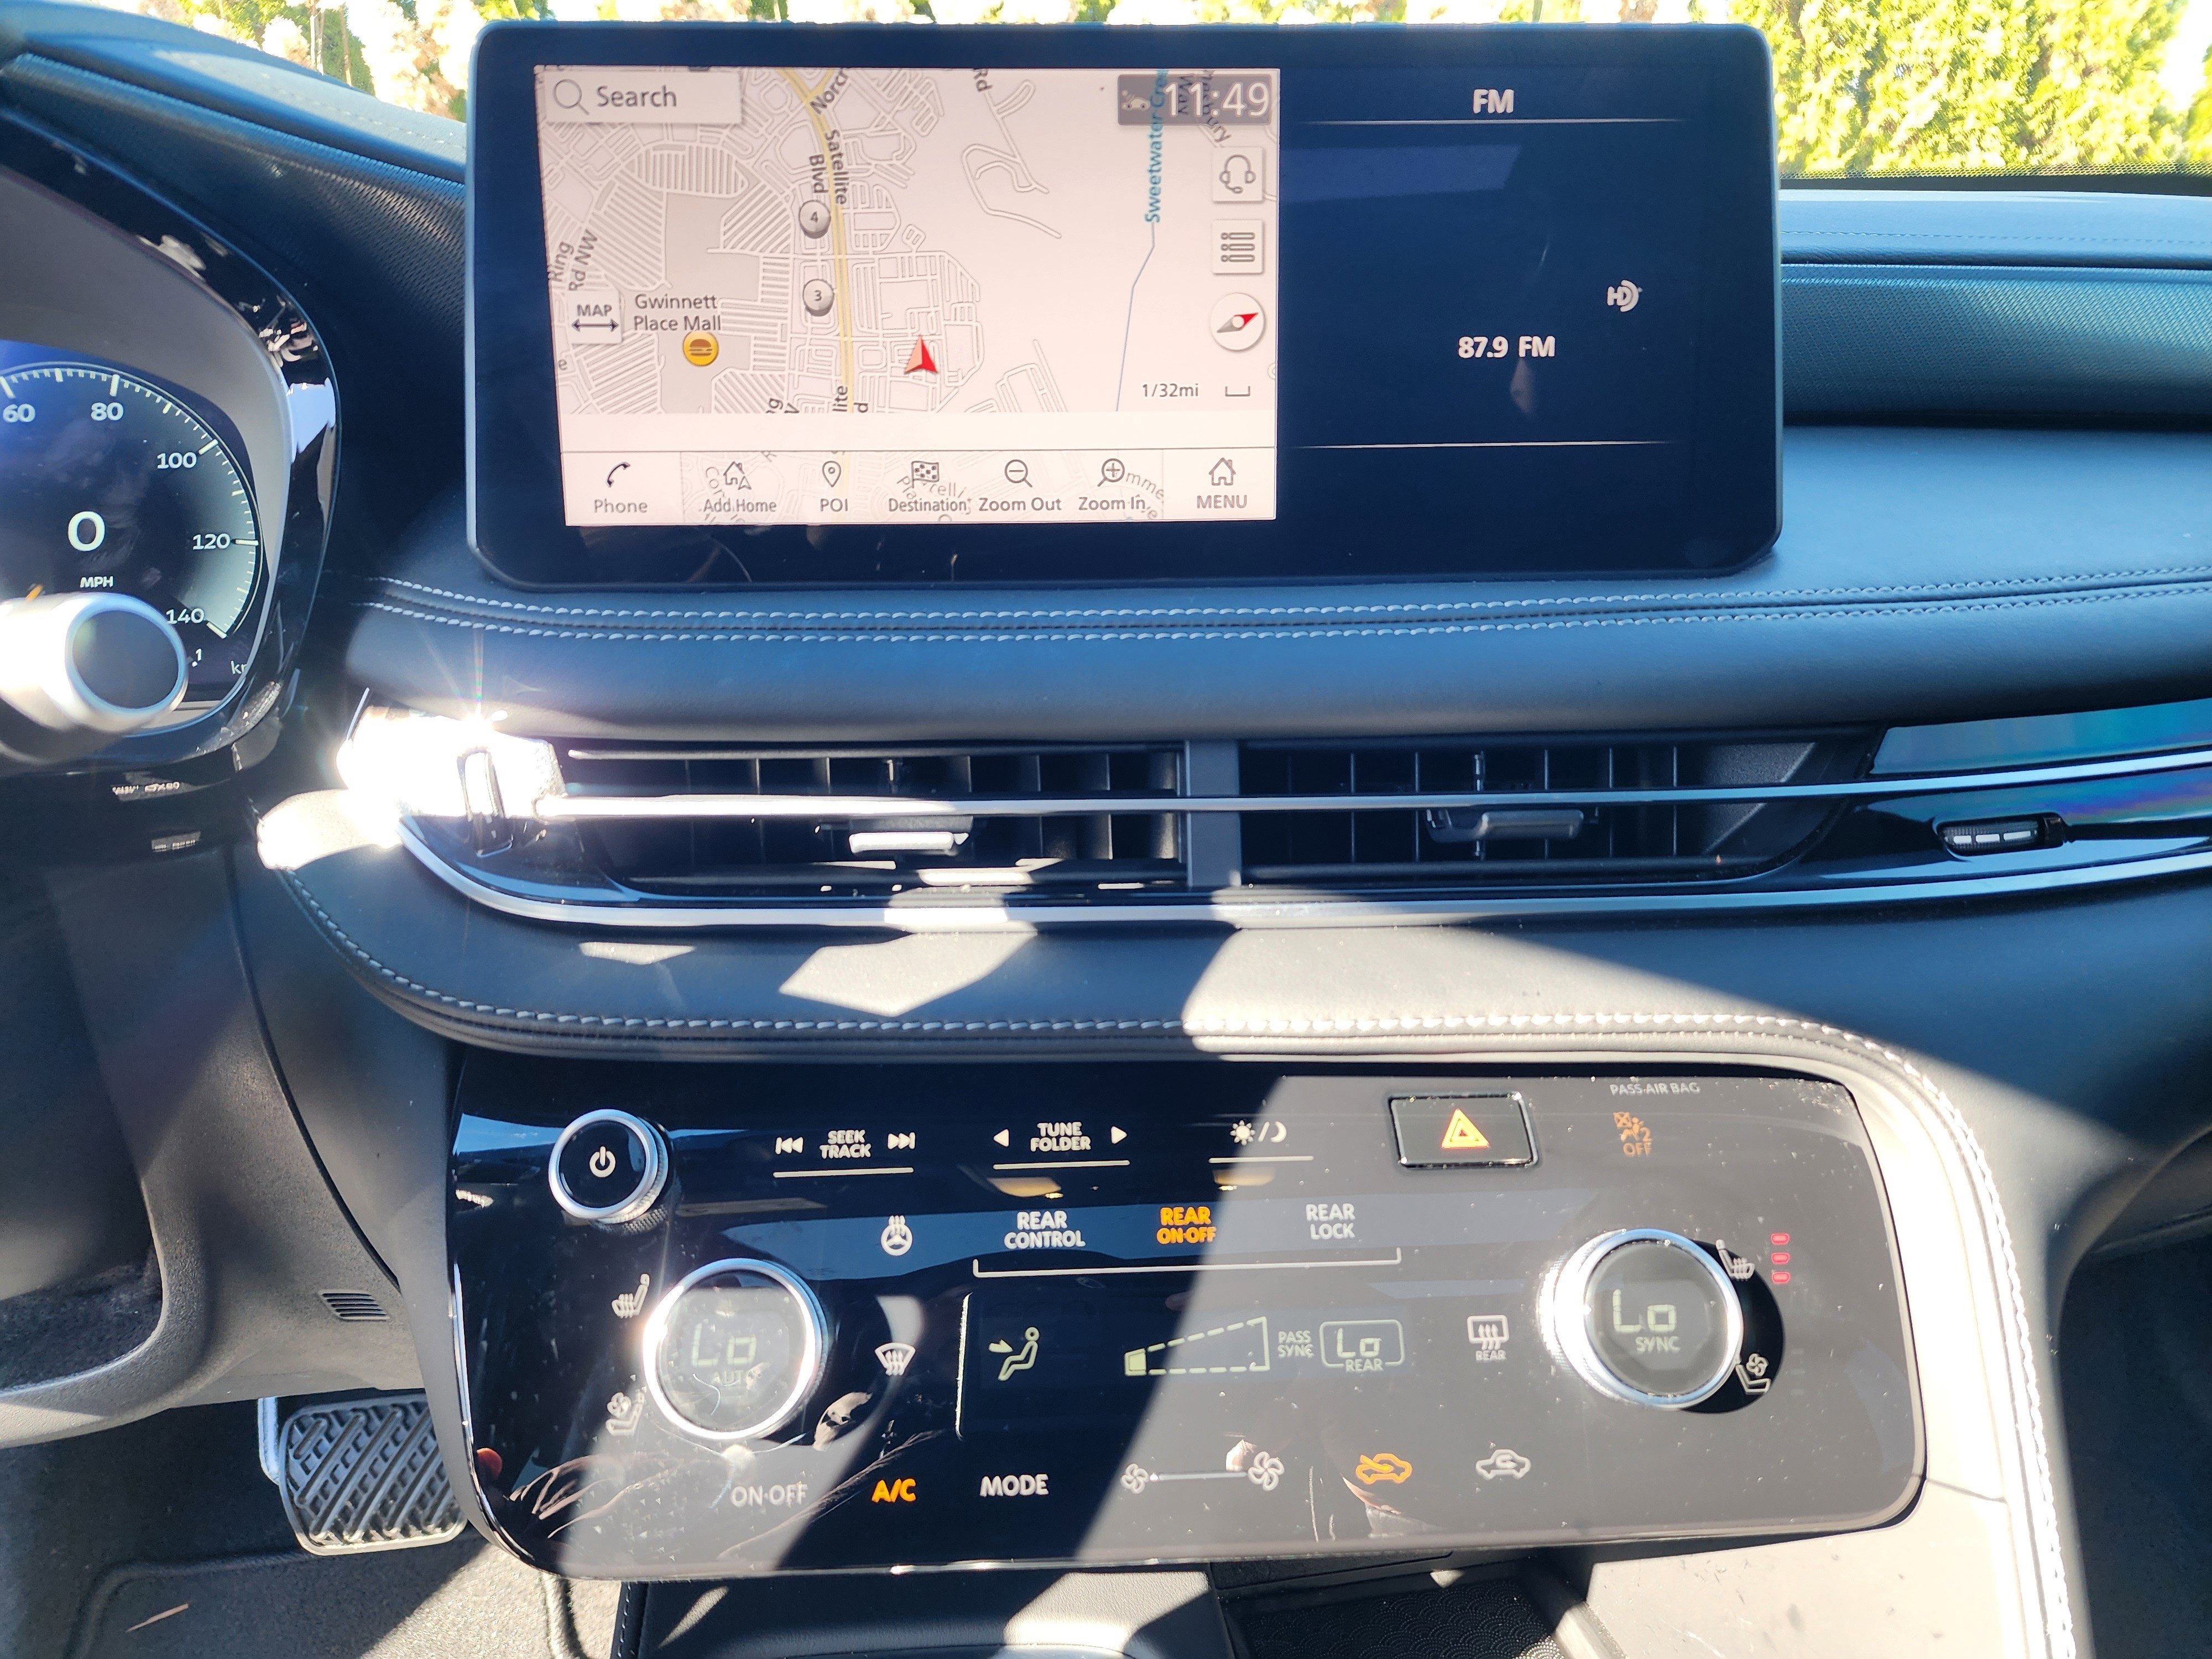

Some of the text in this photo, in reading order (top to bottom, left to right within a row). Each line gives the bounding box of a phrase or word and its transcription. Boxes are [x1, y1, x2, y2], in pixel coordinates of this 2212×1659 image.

[597, 85, 676, 107] Search
[1164, 82, 1269, 117] 11:49
[1473, 89, 1514, 113] FM
[809, 154, 829, 193] Blvd
[825, 129, 849, 205] Satellite
[1145, 112, 1165, 222] Sweetwater
[811, 212, 818, 223] 4
[547, 242, 574, 282] Ring
[568, 228, 597, 291] Rd NW
[635, 294, 717, 310] Gwinnett
[814, 291, 822, 301] 3
[577, 304, 612, 316] MAP
[634, 316, 722, 331] Place Mall
[1458, 336, 1555, 358] 87.9 FM
[1142, 383, 1198, 397] 1/32mi
[3, 404, 35, 422] 60
[91, 403, 124, 421] 80
[156, 452, 197, 469] 100
[594, 499, 648, 513] Phone
[703, 498, 777, 513] Add Home
[820, 498, 849, 512] POI
[888, 498, 967, 512] Destination
[979, 497, 1062, 511] Zoom Out
[1078, 497, 1145, 510] Zoom In
[1197, 495, 1247, 509] MENU
[68, 511, 106, 551] 0
[192, 534, 231, 550] 120
[80, 576, 113, 588] MPH
[166, 608, 205, 624] 140
[1609, 1082, 1700, 1095] PASS AIR BAG
[828, 1129, 865, 1145] SEEK
[1037, 1122, 1082, 1137] TUNE
[819, 1144, 872, 1159] TRACK
[1030, 1136, 1091, 1152] FOLDER
[1623, 1142, 1653, 1157] OFF
[1016, 1211, 1067, 1230] REAR
[1160, 1207, 1211, 1226] REAR
[1306, 1203, 1356, 1222] REAR
[1310, 1222, 1355, 1240] LOCK
[1004, 1230, 1086, 1249] CONTROL
[1613, 1289, 1677, 1333] Lo
[1278, 1331, 1312, 1344] PASS
[1337, 1328, 1381, 1358] Lo
[1635, 1337, 1679, 1352] SYNC
[1278, 1344, 1314, 1358] SYNC
[1475, 1350, 1506, 1361] REAR
[1345, 1359, 1383, 1373] REAR
[872, 1478, 916, 1503] A/C
[980, 1474, 1048, 1496] MODE
